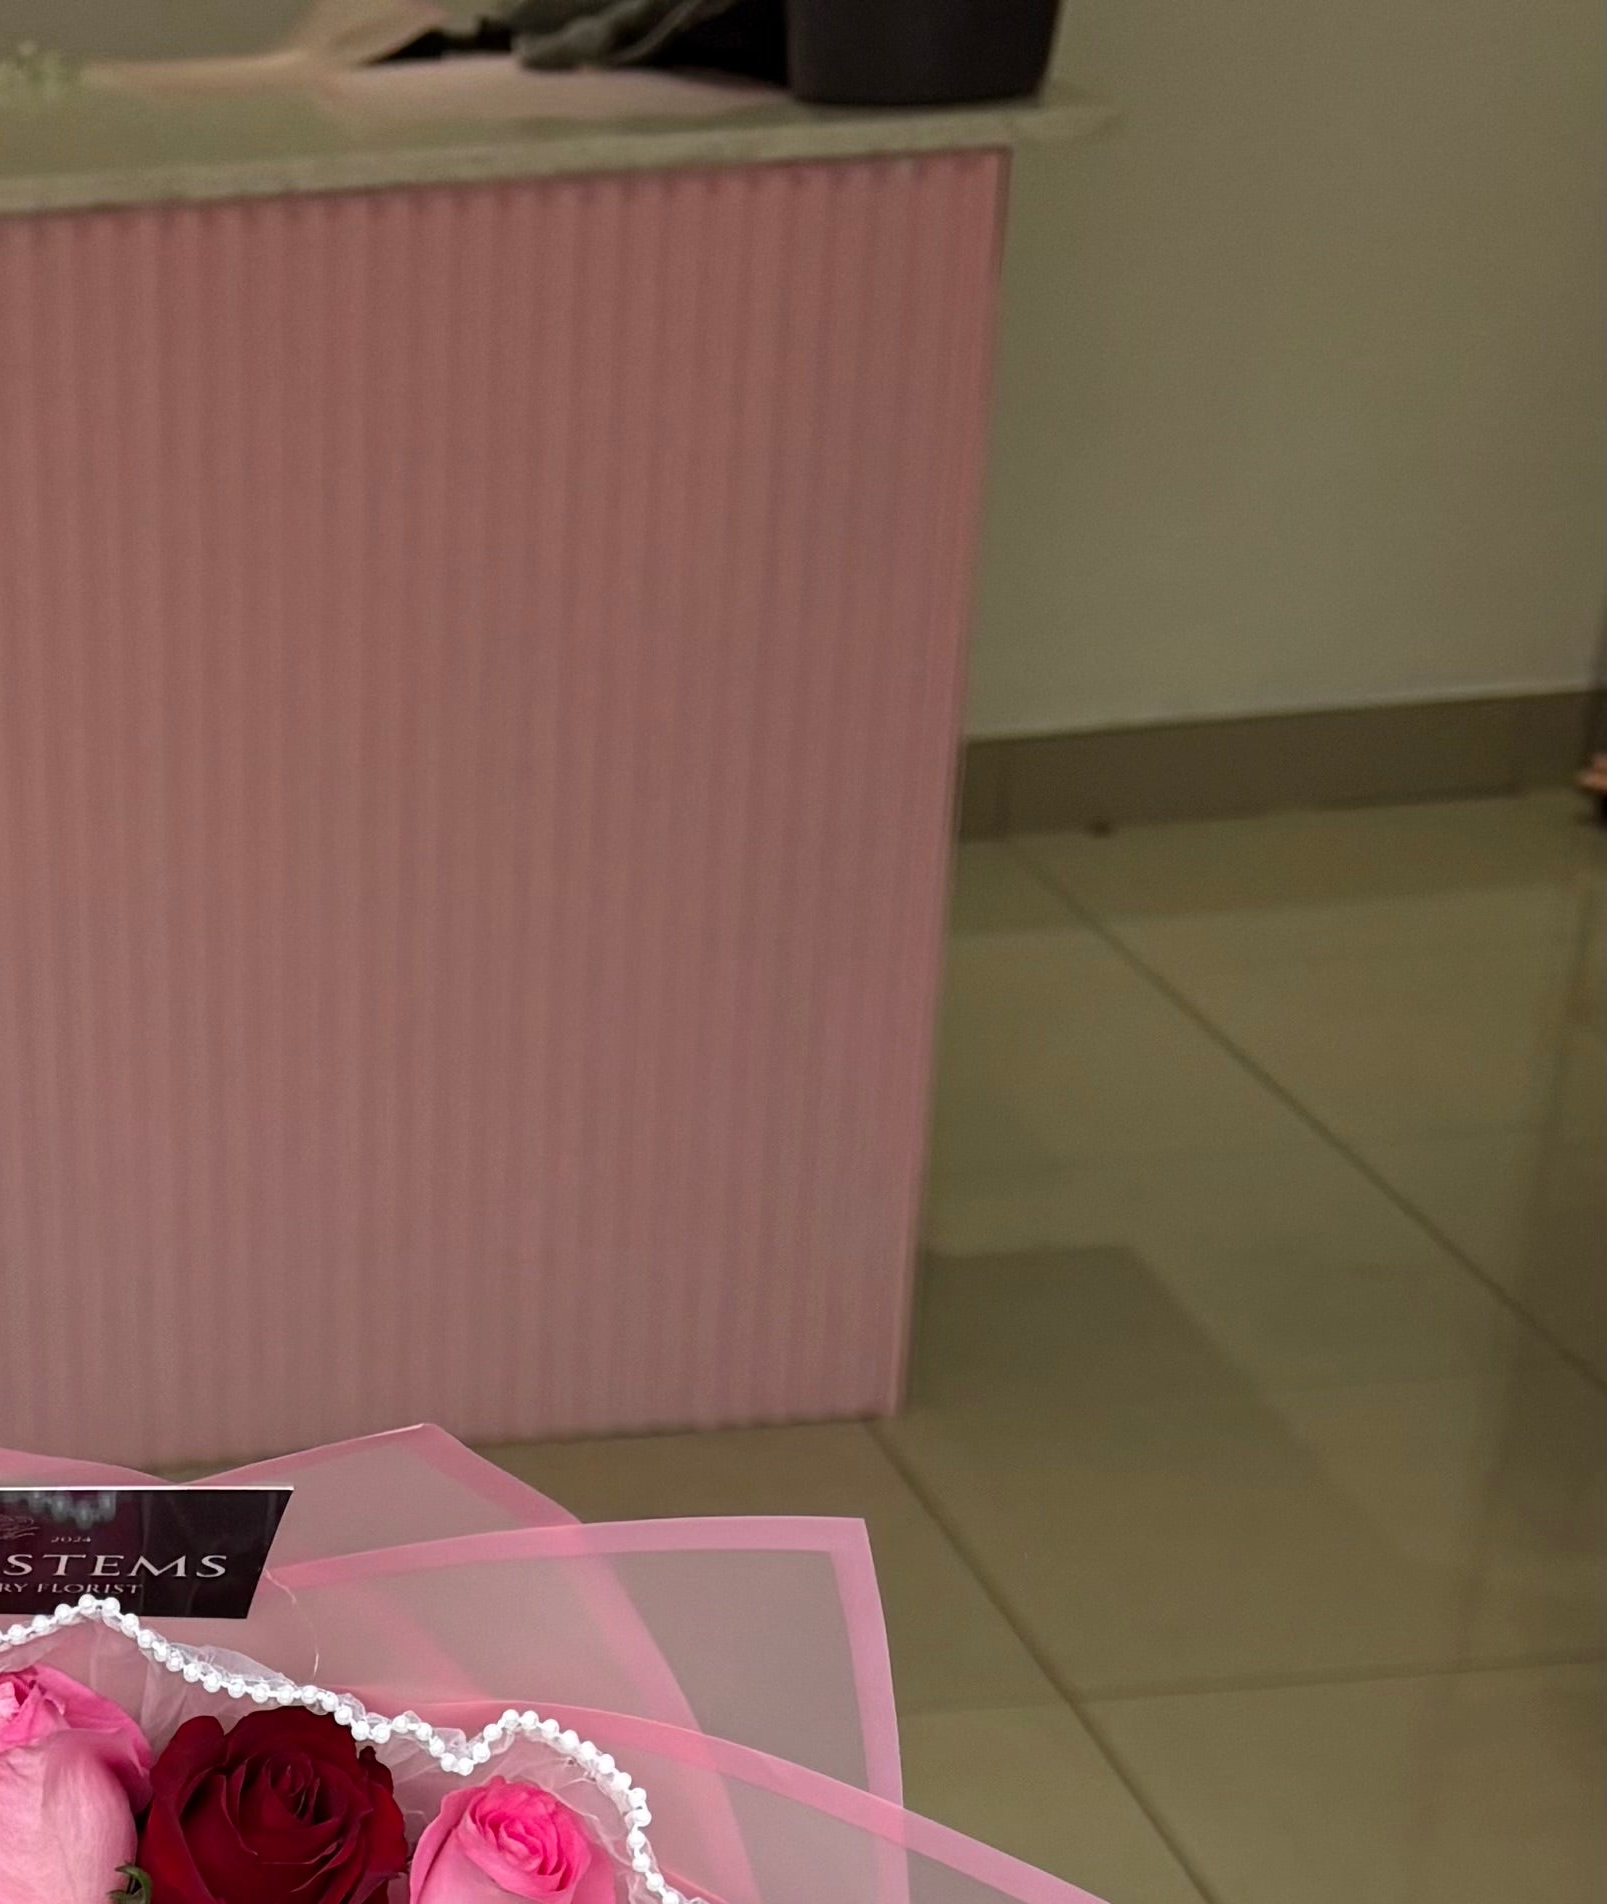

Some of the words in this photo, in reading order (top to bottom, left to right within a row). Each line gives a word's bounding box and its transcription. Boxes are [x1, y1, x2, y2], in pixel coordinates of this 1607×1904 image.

[50, 1535, 92, 1544] 2024
[2, 1553, 228, 1578] STEMS
[36, 1582, 144, 1595] FLORIST
